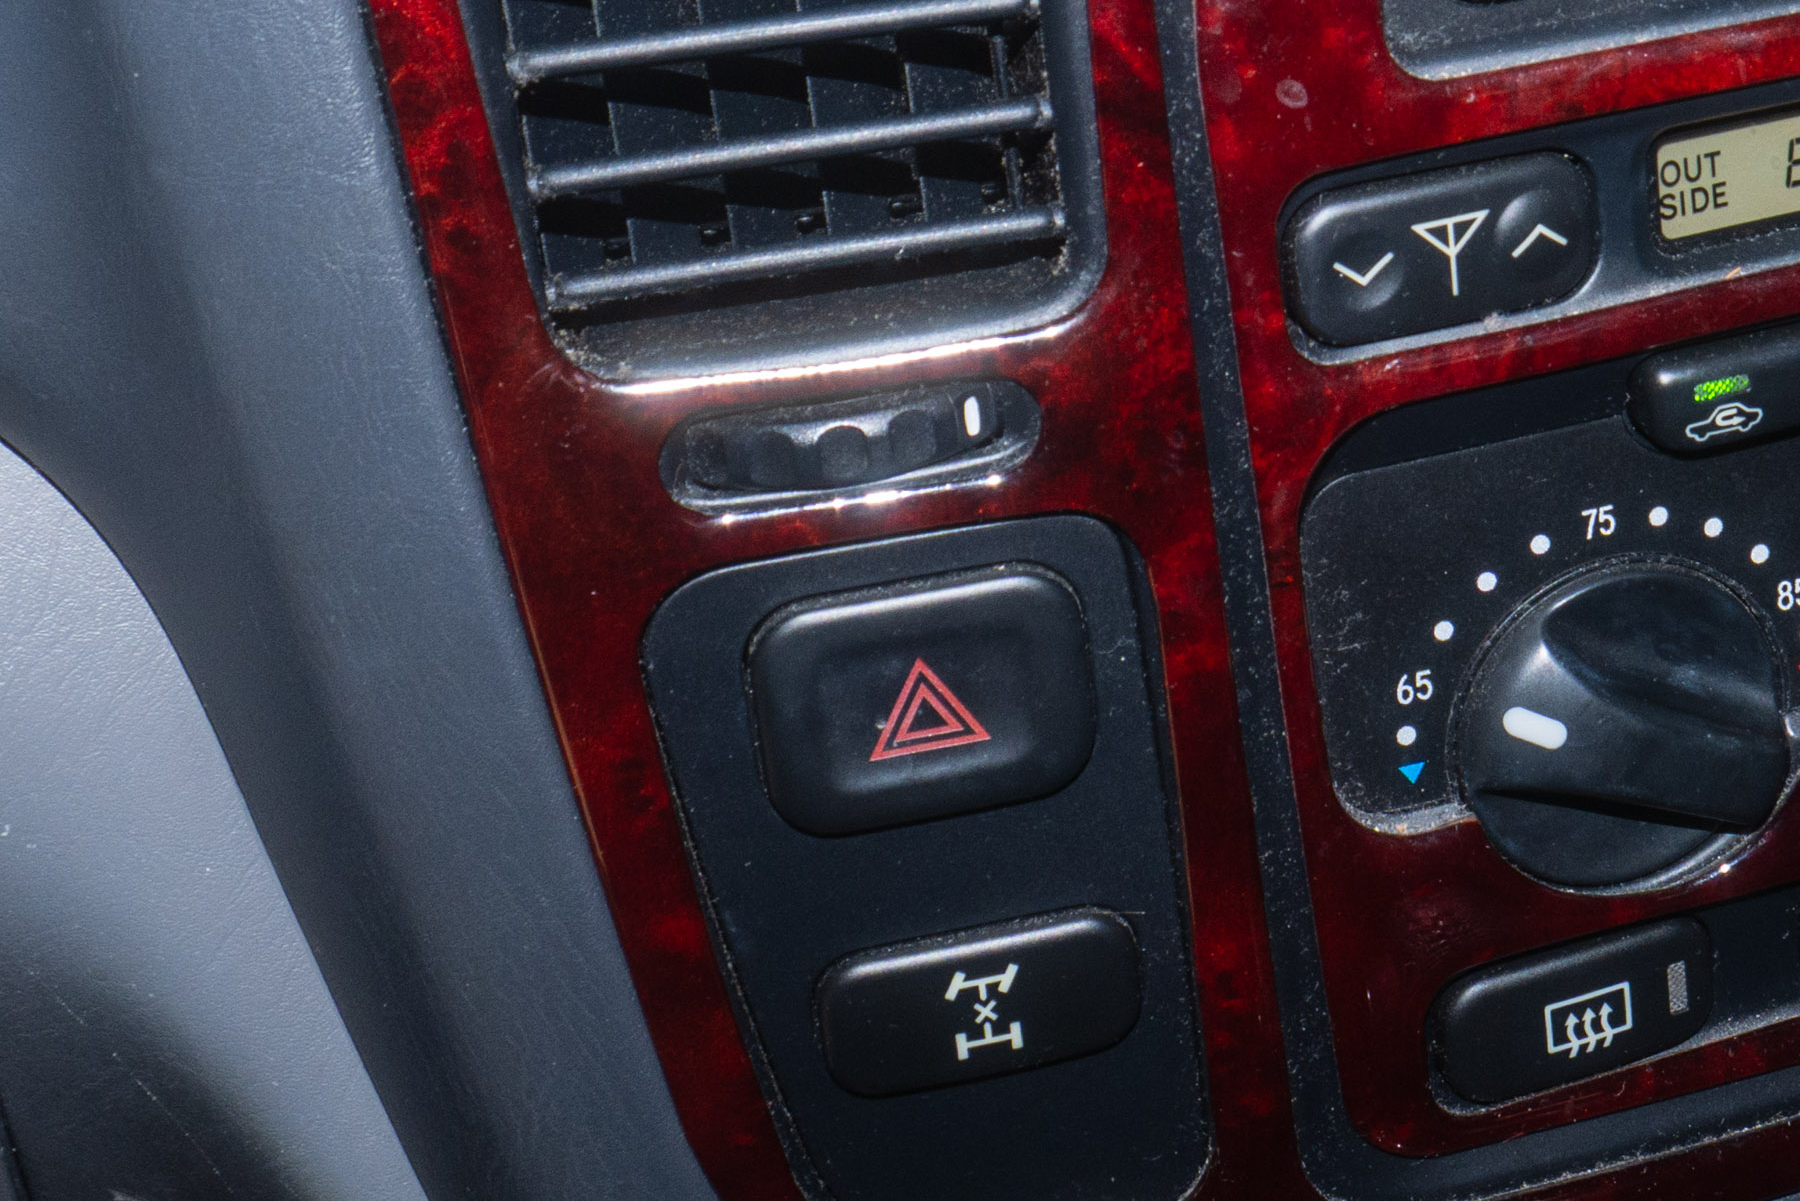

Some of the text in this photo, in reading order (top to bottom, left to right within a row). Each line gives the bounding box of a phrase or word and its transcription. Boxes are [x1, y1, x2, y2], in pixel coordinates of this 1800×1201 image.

[1660, 150, 1721, 187] OUT
[1660, 181, 1729, 221] SIDE
[1581, 504, 1616, 541] 75
[1396, 669, 1433, 705] 65
